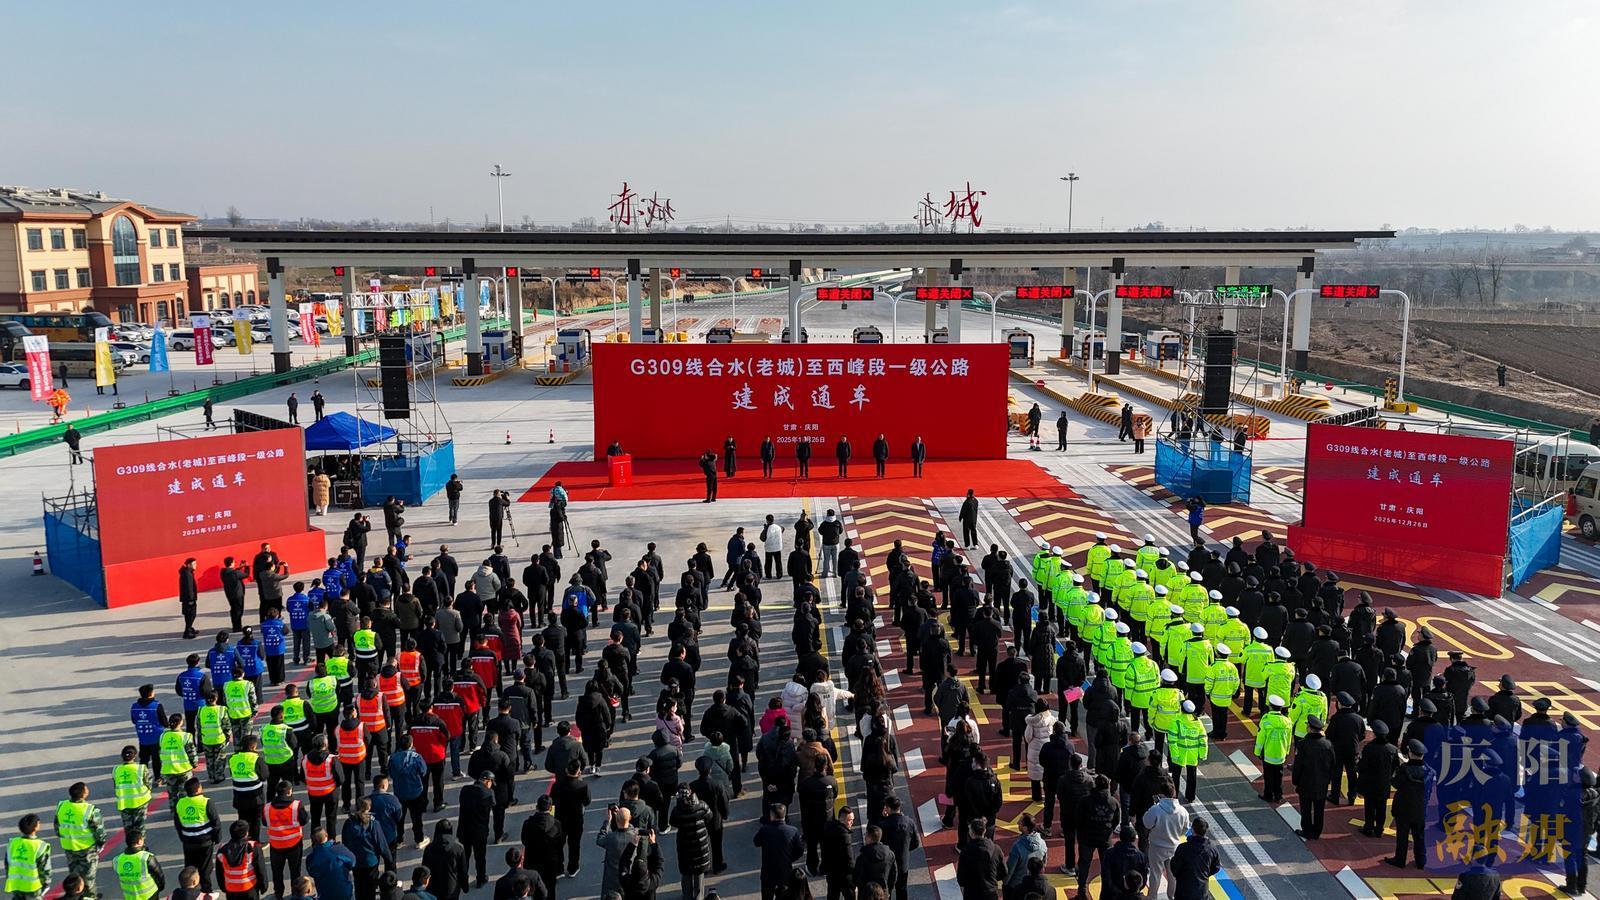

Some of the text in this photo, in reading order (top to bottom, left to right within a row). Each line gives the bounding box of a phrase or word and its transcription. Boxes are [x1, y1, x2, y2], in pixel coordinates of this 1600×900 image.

[818, 287, 862, 300] 车道关闭
[917, 287, 962, 299] 车道关闭
[1016, 286, 1062, 299] 车道关闭
[1117, 286, 1162, 298] 车道关闭
[1322, 286, 1367, 298] 车道关闭
[630, 357, 970, 377] G309线合水(老城)至西峰段一级公路
[731, 382, 871, 411] 建成通车
[1367, 465, 1444, 488] 建成通车
[168, 471, 247, 496] 建成通车
[1374, 515, 1429, 528] 2025年12月26日
[182, 523, 238, 537] 2025年12月26日
